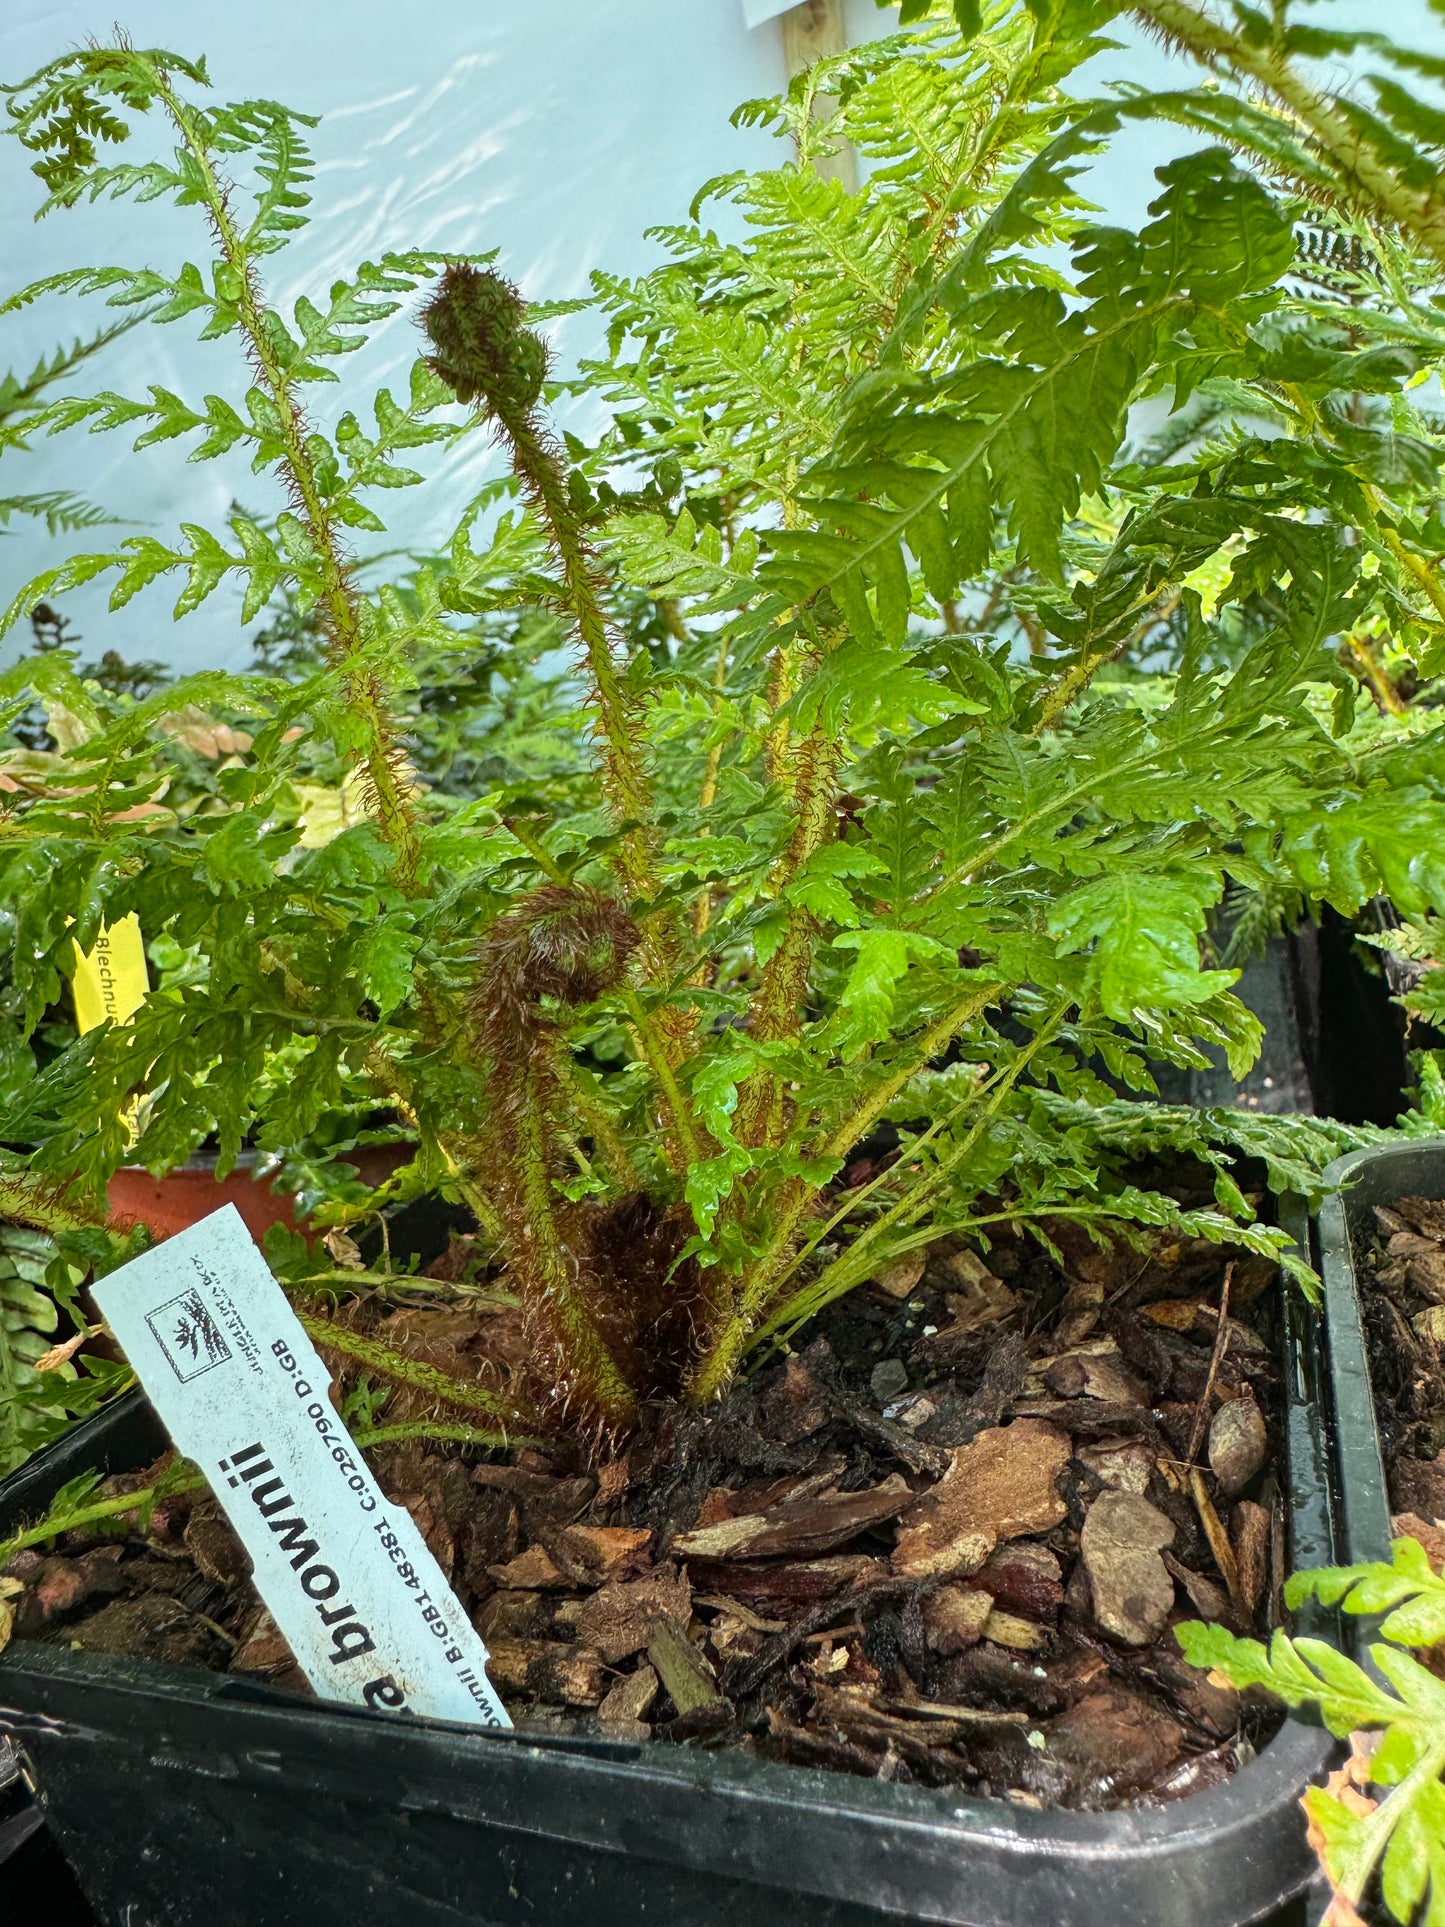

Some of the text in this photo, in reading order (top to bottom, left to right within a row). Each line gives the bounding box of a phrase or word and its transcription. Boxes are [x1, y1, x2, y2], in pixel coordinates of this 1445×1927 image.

[270, 1338, 313, 1399] D:GB
[307, 1402, 377, 1512] C:029790
[218, 1441, 377, 1666] brownii
[373, 1516, 465, 1664] B:GB148381
